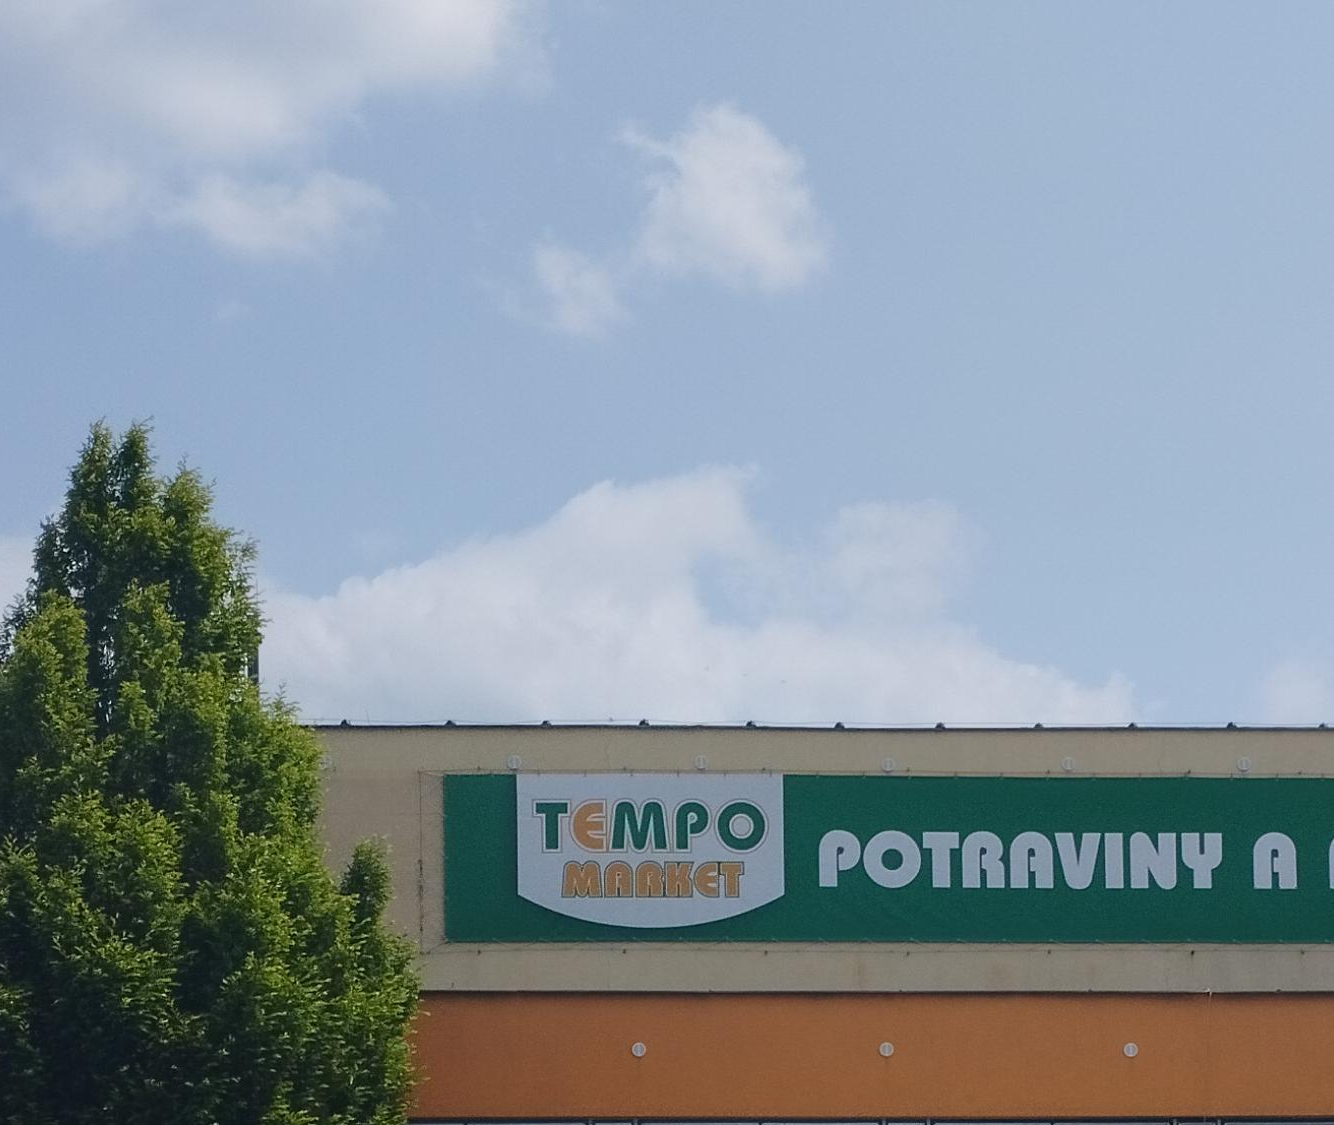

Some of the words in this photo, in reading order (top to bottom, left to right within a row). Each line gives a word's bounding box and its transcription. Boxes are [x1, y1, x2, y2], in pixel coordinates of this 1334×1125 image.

[532, 799, 768, 854] TEMPO
[561, 860, 745, 899] MARKET
[818, 829, 1223, 889] POTRAVINY
[1253, 832, 1298, 889] A
